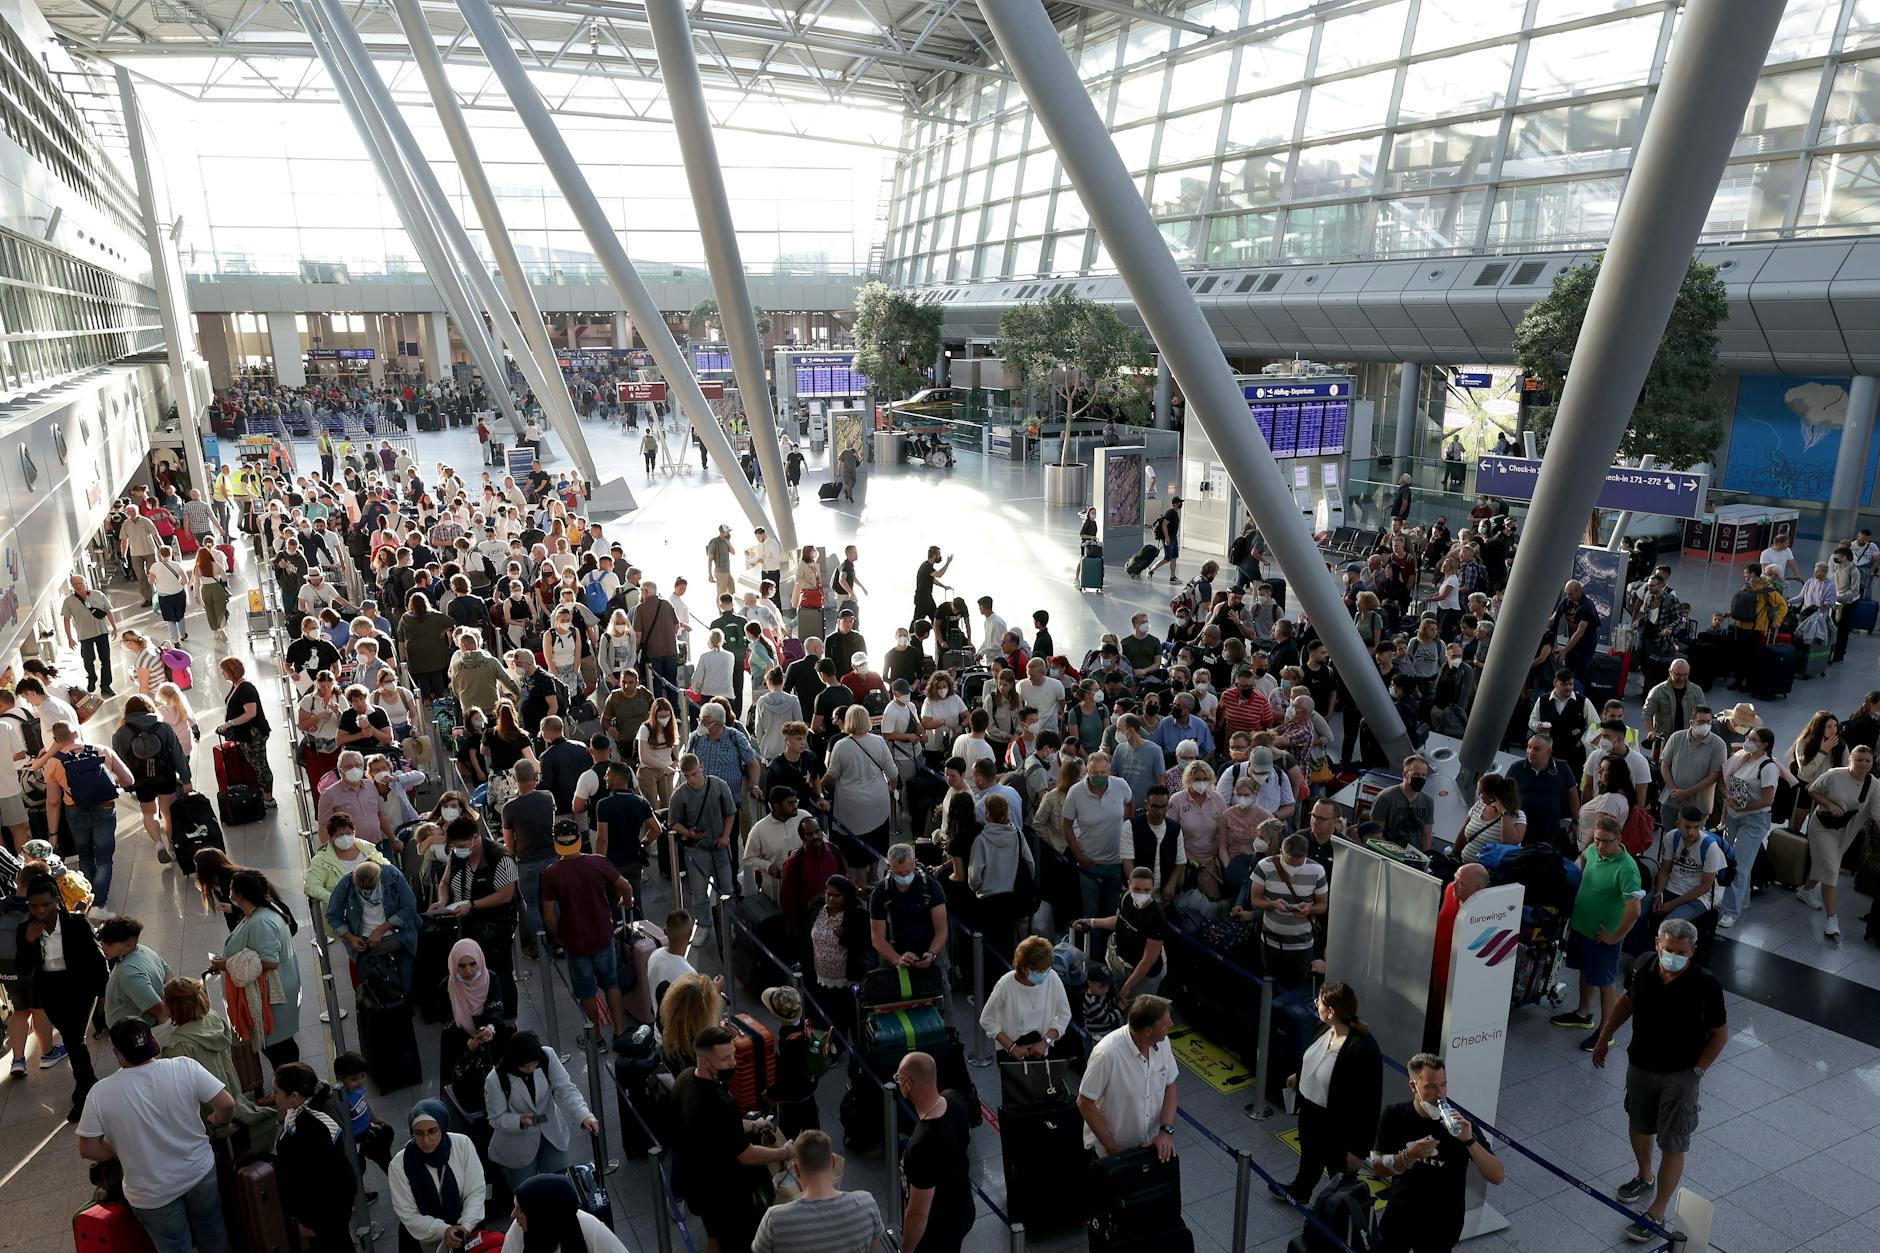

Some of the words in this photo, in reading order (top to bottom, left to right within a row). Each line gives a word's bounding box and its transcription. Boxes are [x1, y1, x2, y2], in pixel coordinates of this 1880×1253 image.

[1508, 464, 1536, 474] Check-in
[1605, 474, 1628, 482] eck-in
[1629, 476, 1661, 486] 171-272
[1470, 912, 1506, 924] Eurowings
[1451, 1027, 1503, 1049] Check-in
